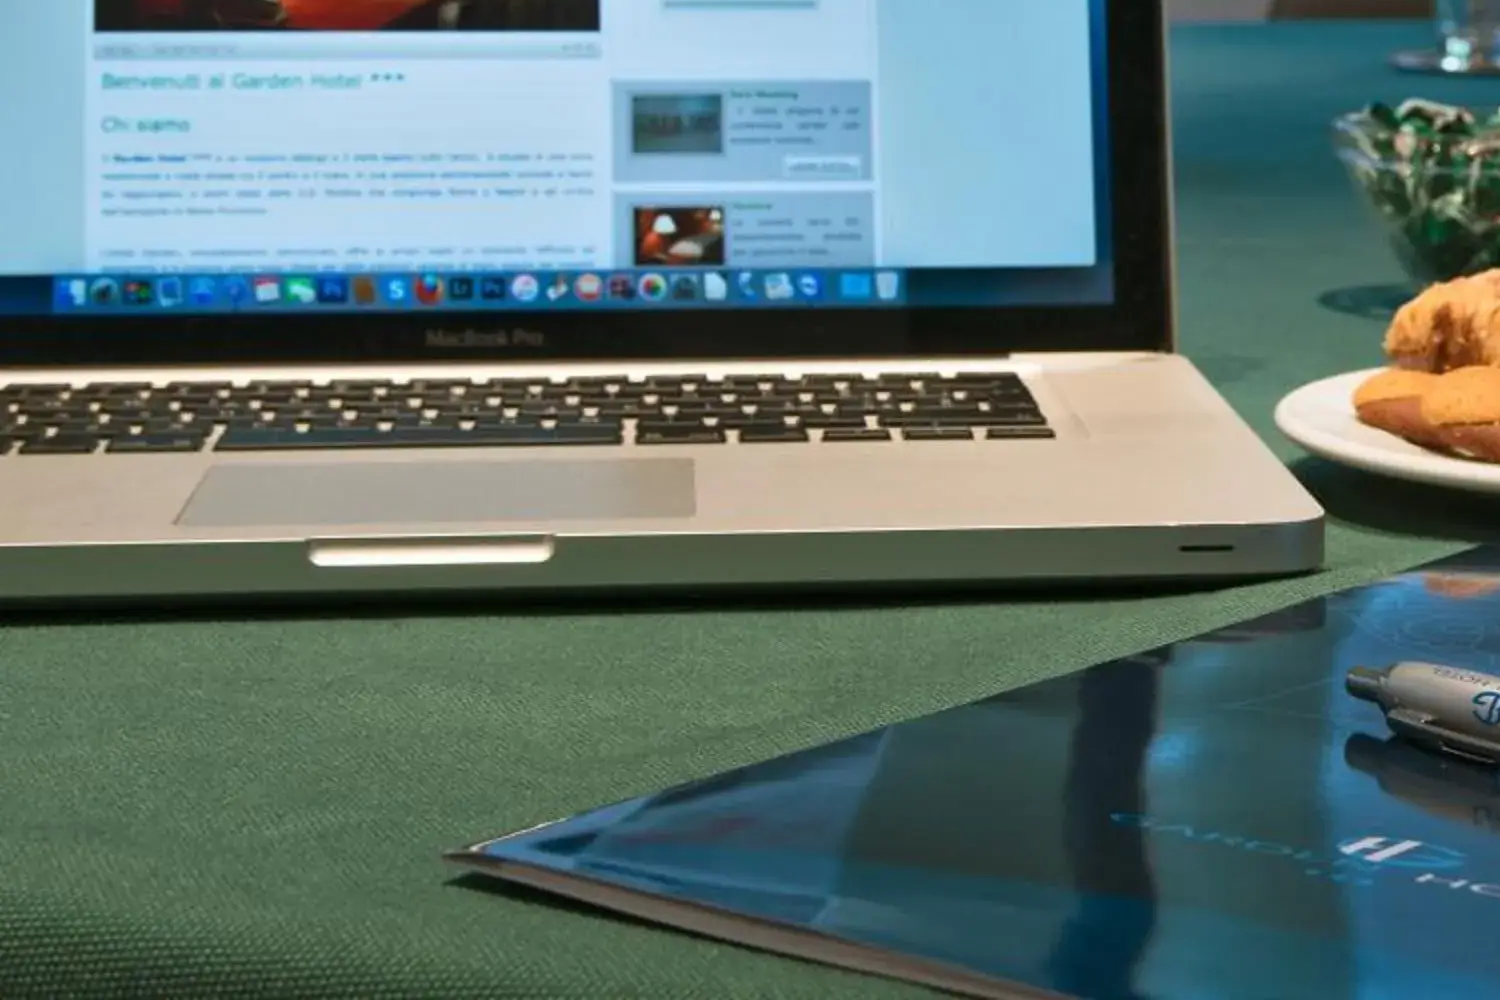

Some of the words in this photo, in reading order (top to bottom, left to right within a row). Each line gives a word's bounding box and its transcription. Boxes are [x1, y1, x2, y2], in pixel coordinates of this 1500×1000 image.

[232, 72, 303, 89] Garden
[311, 73, 362, 89] Hotel
[137, 117, 191, 135] siamo
